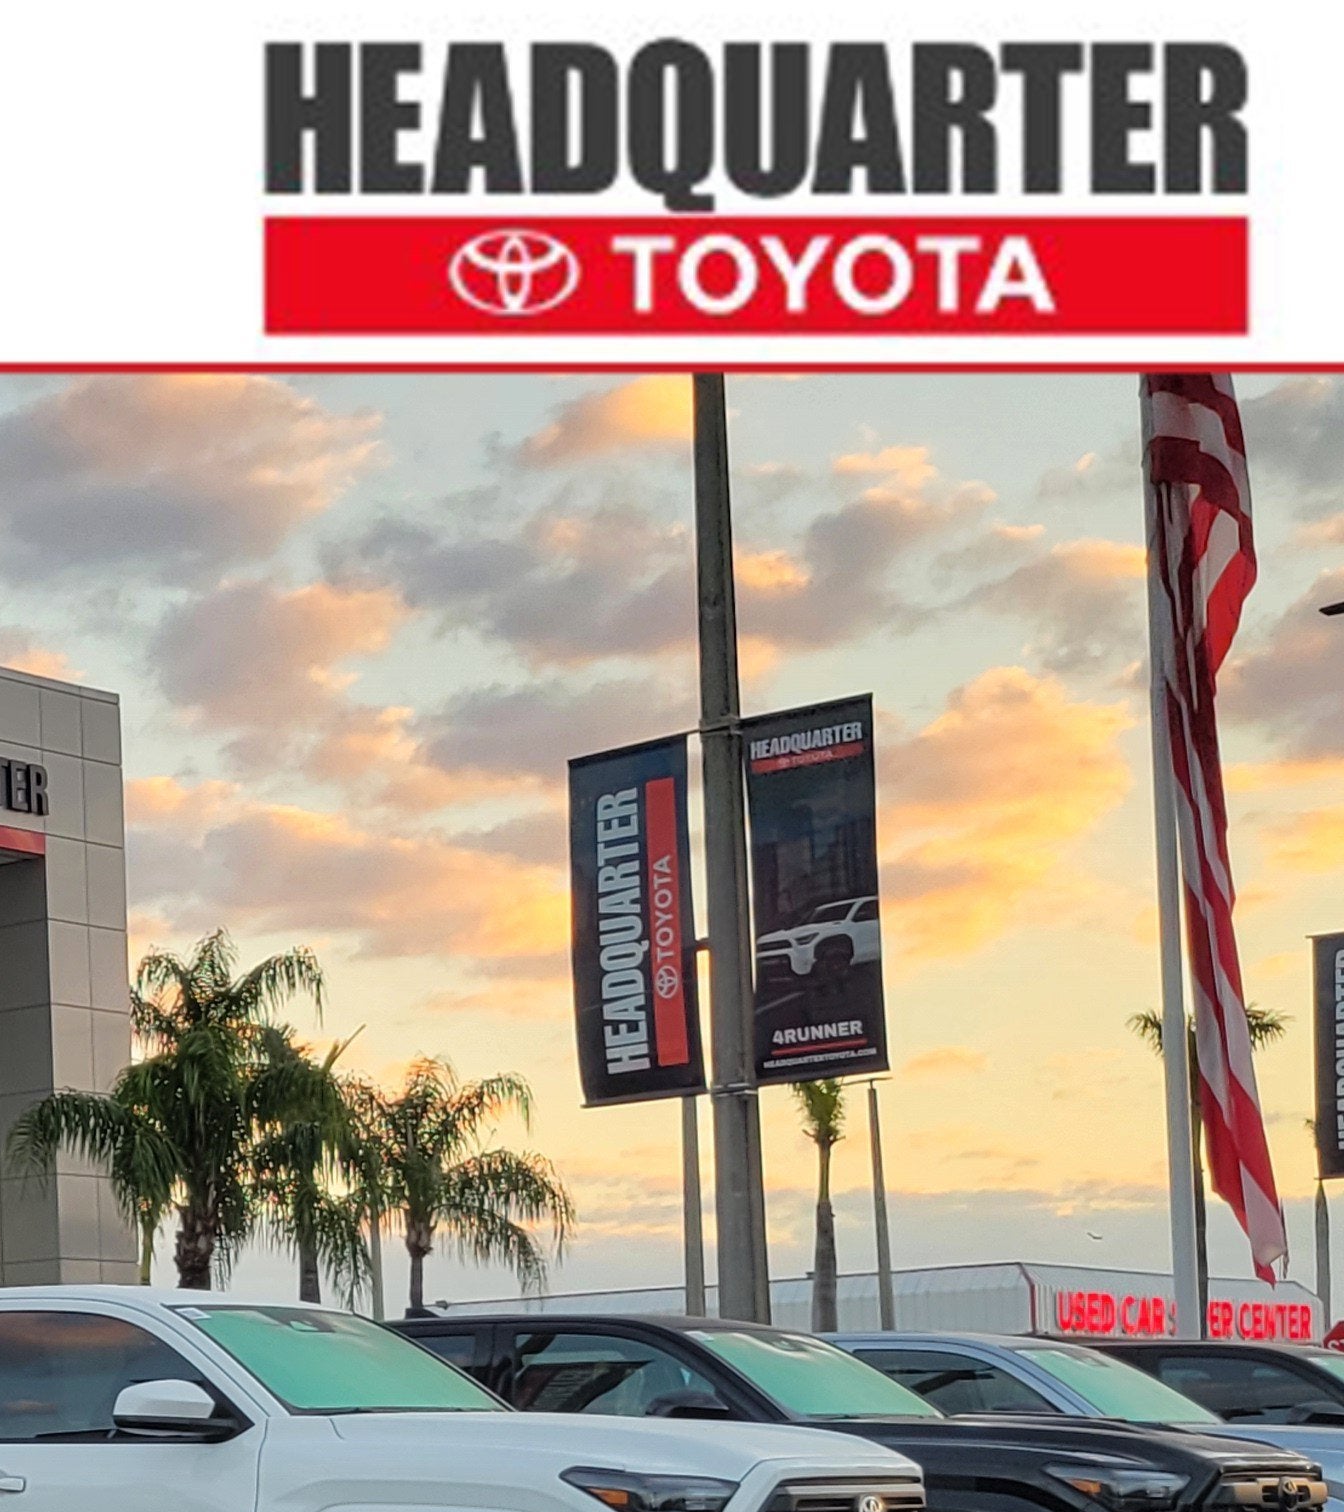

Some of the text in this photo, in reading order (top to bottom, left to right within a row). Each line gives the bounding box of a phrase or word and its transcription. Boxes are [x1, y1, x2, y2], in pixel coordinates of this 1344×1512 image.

[750, 721, 863, 760] HEADQUARTER
[596, 787, 651, 1075] HEADQUARTER
[653, 854, 675, 962] TOYOTA
[772, 1020, 864, 1045] 4RUNNER
[1056, 1291, 1116, 1334] USED
[1120, 1295, 1166, 1336] CAR
[1238, 1302, 1312, 1341] CENTER
